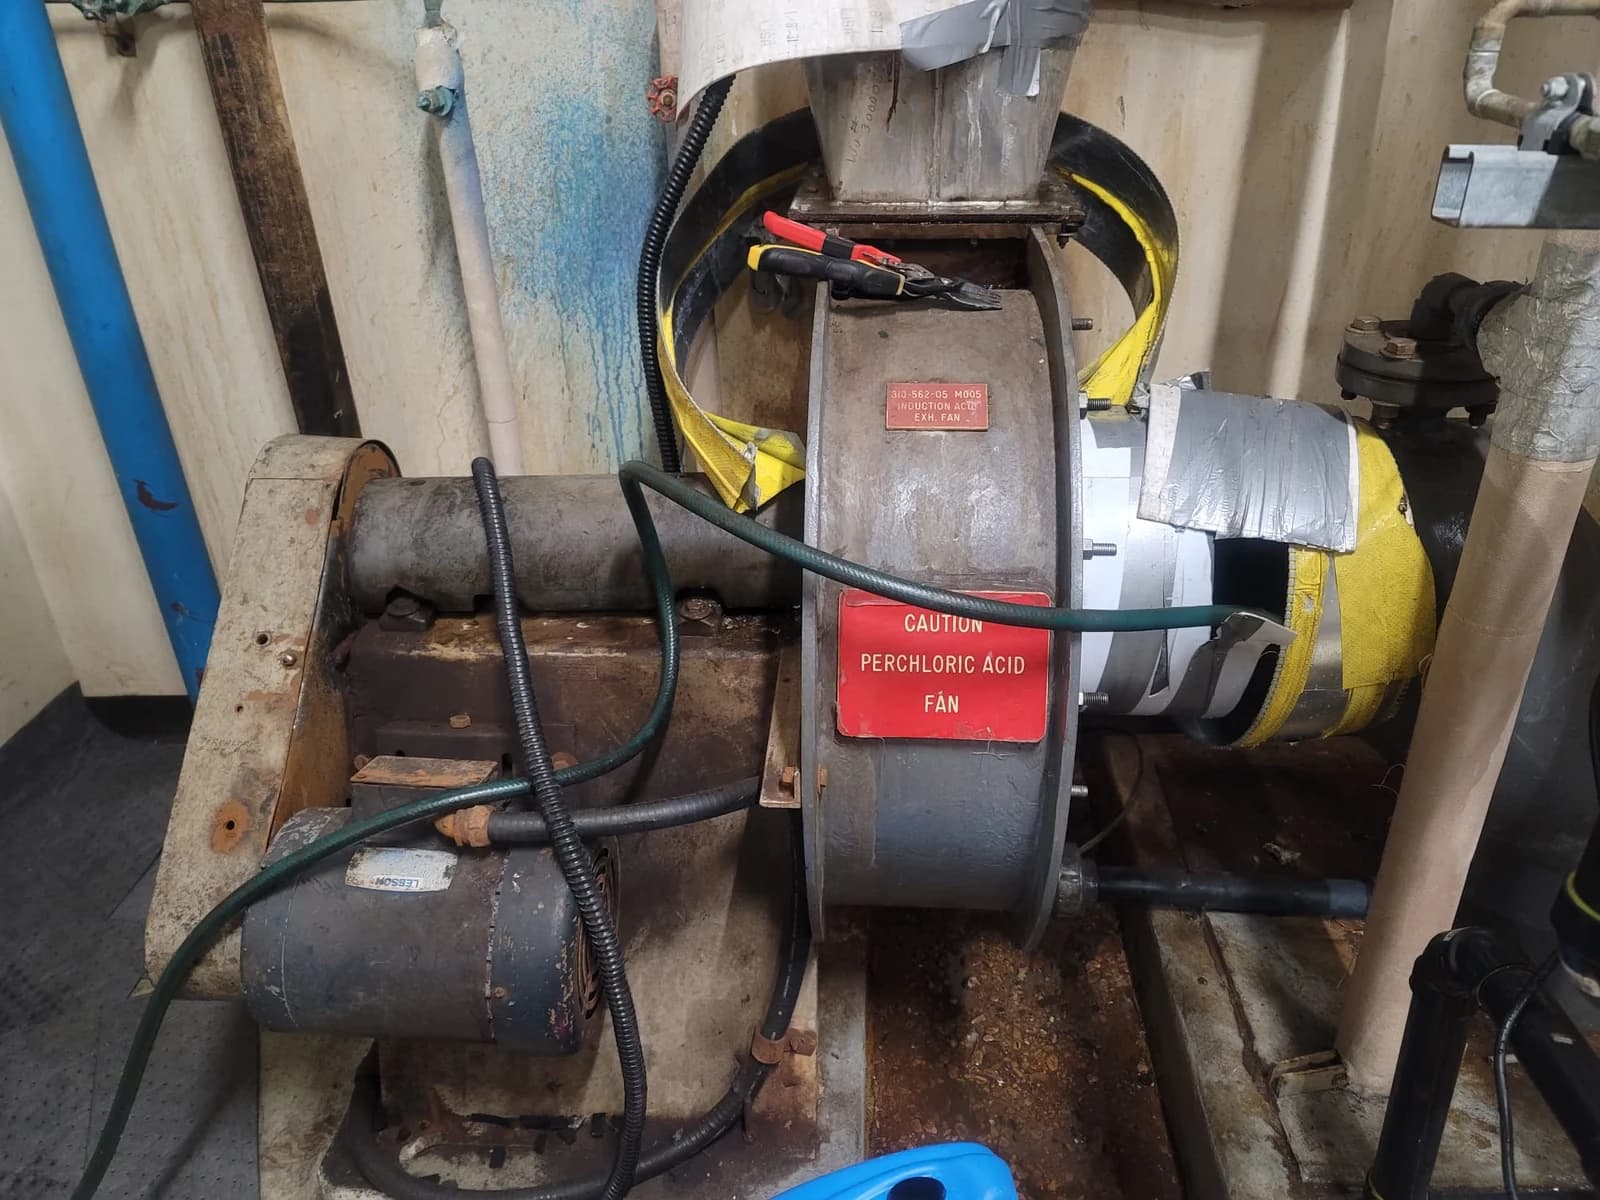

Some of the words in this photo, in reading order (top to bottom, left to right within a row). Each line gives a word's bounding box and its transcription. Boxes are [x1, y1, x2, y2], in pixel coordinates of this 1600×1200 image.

[954, 390, 982, 399] M005
[897, 401, 951, 411] INDUCTION
[914, 412, 938, 422] EXH.
[941, 413, 961, 422] FAN
[904, 613, 983, 633] CAUTION
[860, 653, 976, 674] PERCHLORIC
[982, 655, 1026, 675] ACID
[924, 694, 960, 713] FAN
